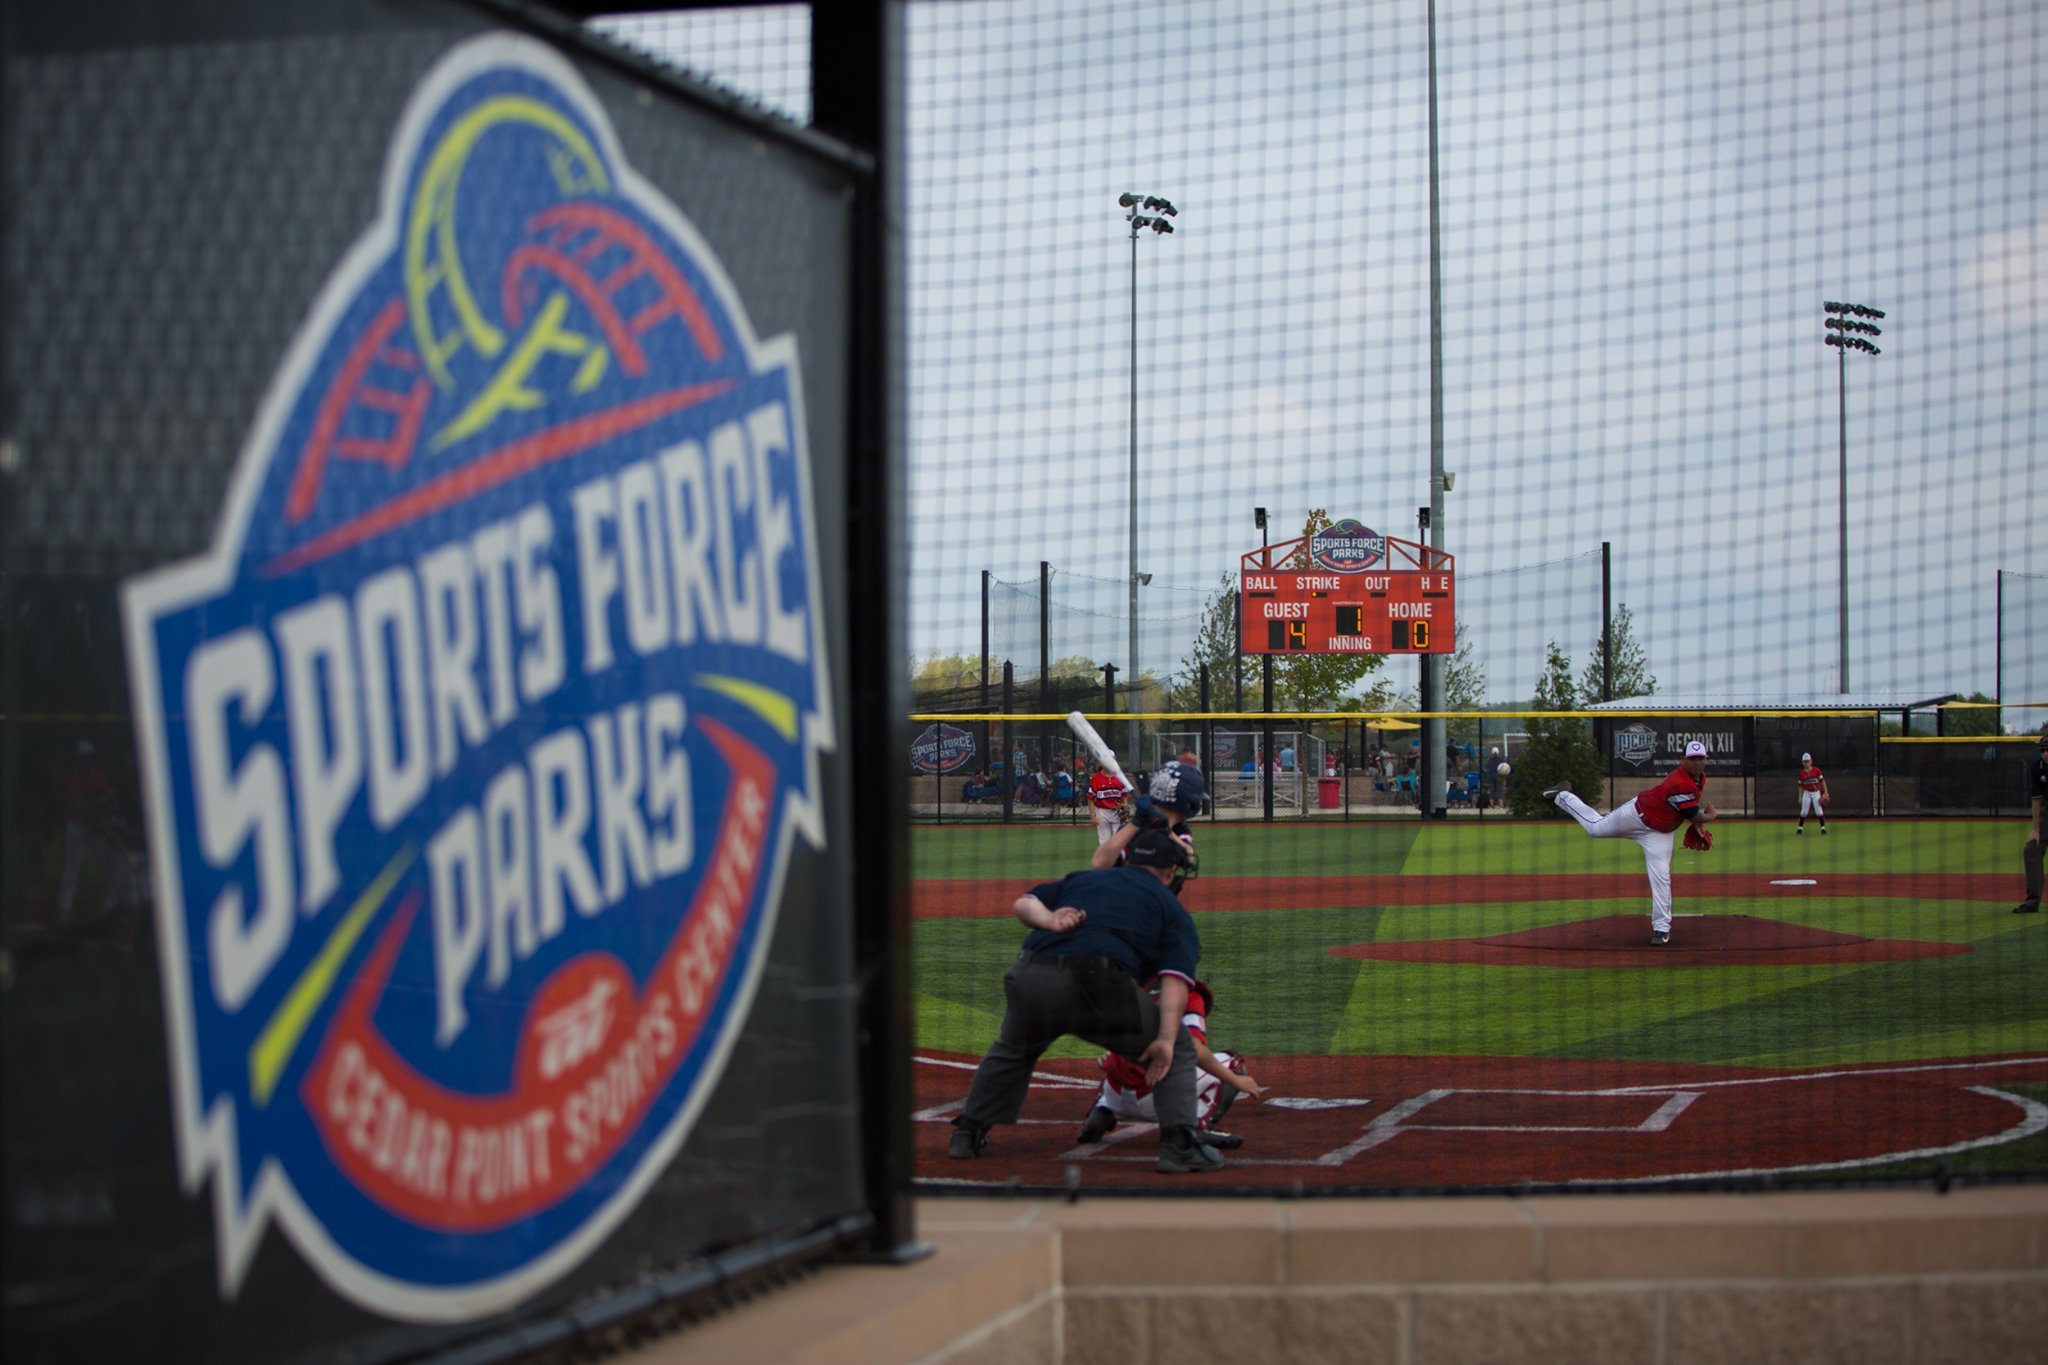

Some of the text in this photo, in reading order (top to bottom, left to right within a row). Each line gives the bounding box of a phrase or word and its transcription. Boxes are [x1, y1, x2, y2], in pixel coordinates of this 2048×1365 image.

[1313, 538, 1384, 552] SPORTS FORCE
[1333, 548, 1364, 559] PARKS
[1246, 577, 1448, 590] BALL STRIKE OUT H E
[1264, 602, 1310, 618] GUEST
[1389, 602, 1432, 618] HOME
[1290, 622, 1306, 647] 4
[1413, 620, 1429, 648] 0
[1329, 637, 1372, 650] INNING
[186, 402, 807, 1012] SPORTS FORCE
[943, 735, 972, 749] FORCE
[1617, 732, 1653, 753] NJCAA
[1716, 732, 1734, 752] XII
[428, 693, 694, 1048] PARKS
[327, 1040, 452, 1199] CEDAR
[454, 1107, 554, 1203] POINT
[674, 778, 764, 1016] CENTER
